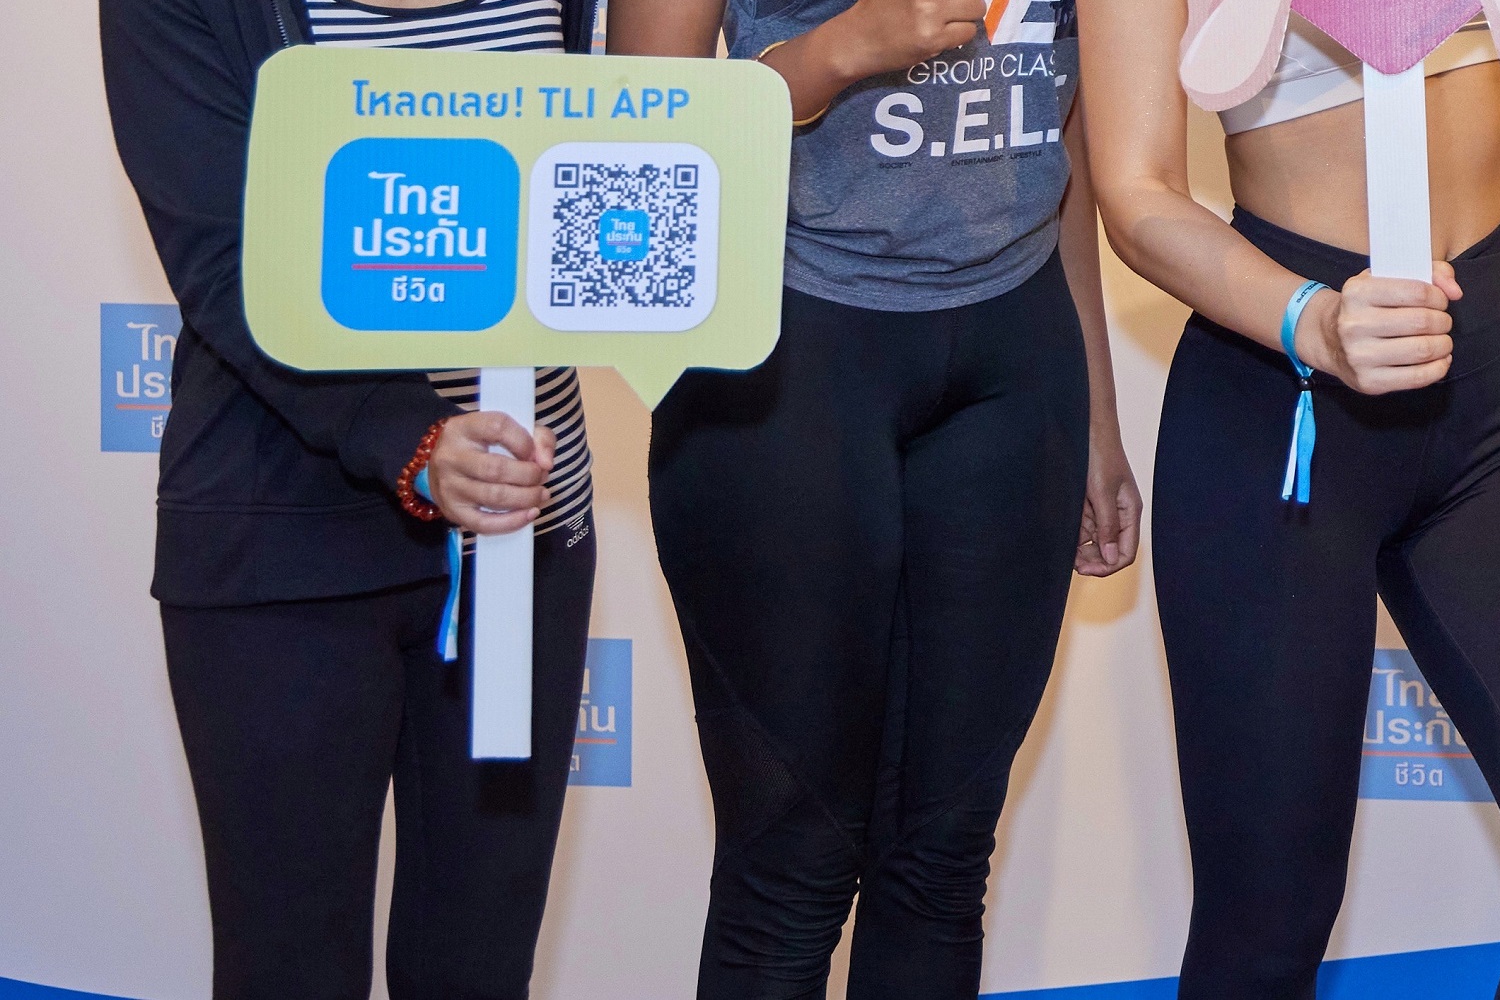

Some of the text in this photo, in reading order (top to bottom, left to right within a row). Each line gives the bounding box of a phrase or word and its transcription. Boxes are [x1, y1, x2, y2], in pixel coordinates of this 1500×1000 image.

[907, 56, 995, 85] GROUP
[352, 79, 691, 119] โหลดเลย! TLI APP
[368, 171, 460, 216] ไทย
[353, 218, 487, 257] ประกัน
[391, 275, 446, 303] ชีวิต
[126, 322, 178, 361] ไท
[1395, 761, 1443, 786] ชีวิต
